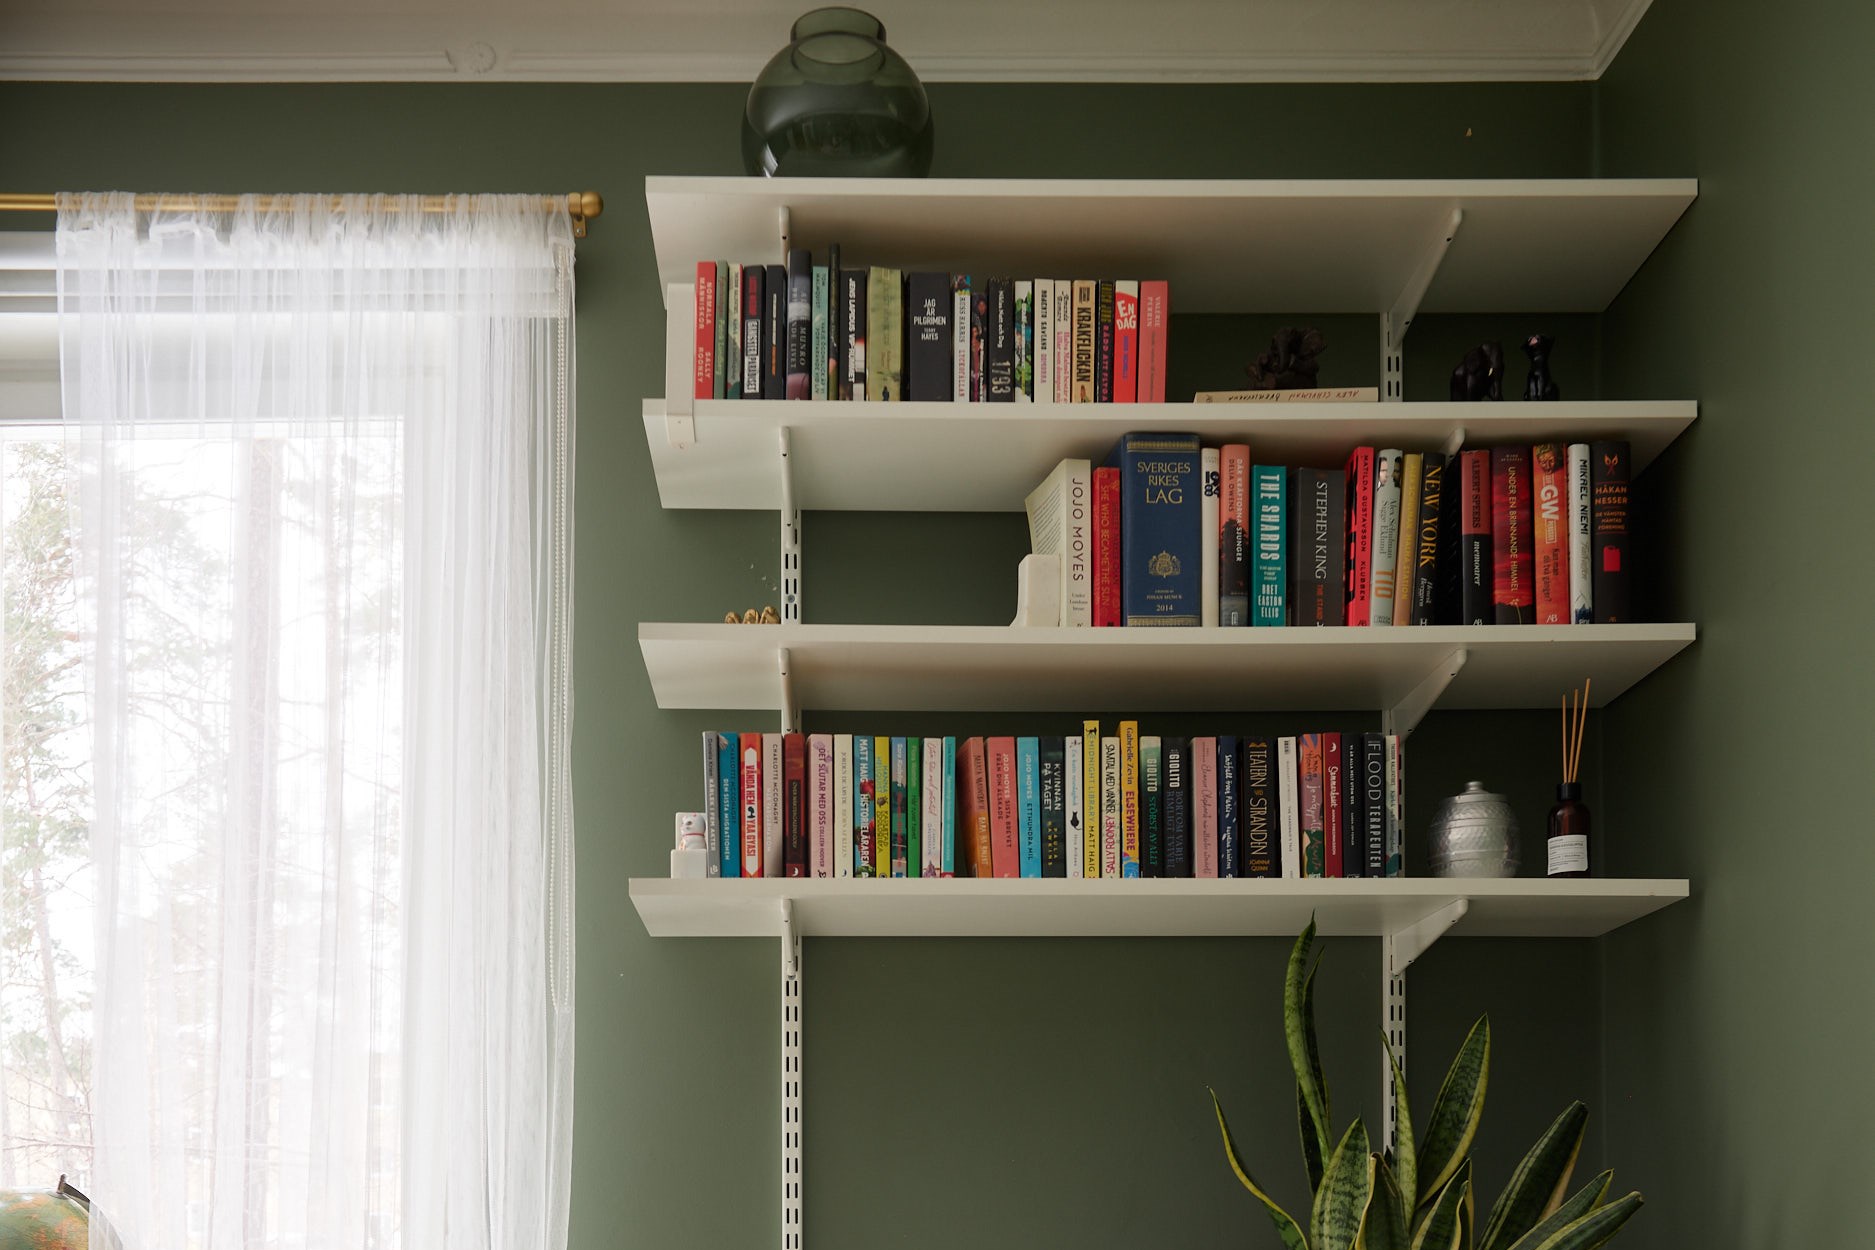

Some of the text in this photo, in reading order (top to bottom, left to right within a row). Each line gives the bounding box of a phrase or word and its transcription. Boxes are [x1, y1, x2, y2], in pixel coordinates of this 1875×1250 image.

[698, 277, 706, 330] MÄNNISKOR
[848, 300, 856, 332] LAPIDUS
[924, 299, 936, 308] JAG
[1116, 300, 1135, 318] EN
[913, 316, 947, 326] PILGRIMEN
[921, 332, 939, 341] HAYES
[1116, 315, 1137, 331] DAG
[799, 327, 807, 367] MUNRO
[697, 347, 705, 382] ROONEY
[991, 360, 1011, 394] 1793
[1101, 372, 1109, 402] FLYGA
[1137, 461, 1191, 474] SVERIGES
[1148, 475, 1180, 487] RIKES
[1507, 467, 1518, 495] UNDER
[1146, 488, 1183, 504] LAG
[1260, 474, 1280, 500] THE
[1471, 458, 1482, 529] ALBERT SPEERS
[1508, 496, 1517, 508] EN
[1540, 484, 1560, 520] GW
[1579, 459, 1589, 535] MIKAEL NIEMI
[1594, 497, 1628, 505] NESSER
[1595, 484, 1627, 494] HÅKAN
[1072, 477, 1084, 582] JOJO MOYES
[1315, 481, 1328, 580] STEPHEN KING
[1359, 455, 1369, 601] MATILDA GUSTAVSSON KLUBBEN
[1386, 498, 1398, 559] Alex Schulman
[1419, 464, 1443, 569] NEW YORK
[1100, 485, 1110, 606] SHE WHO BECAME THE SUN
[1235, 526, 1243, 562] SJUNGER
[1260, 504, 1280, 561] SHARDS
[1378, 525, 1389, 555] Eklund
[1508, 510, 1518, 559] BRINNANDE
[1472, 540, 1482, 587] memoarer
[1510, 560, 1519, 592] HIMMEL
[1261, 584, 1277, 595] BRET
[1375, 569, 1394, 599] TID
[1401, 565, 1411, 600] STATION
[1155, 603, 1173, 612] 2014
[1258, 595, 1282, 606] EASTON
[1261, 607, 1279, 618] ELLIS
[818, 748, 826, 761] DET
[1002, 753, 1010, 772] JOJO
[1105, 744, 1115, 770] SAMTAL
[1126, 727, 1134, 785] Gabrielle Zevin
[818, 763, 826, 791] SLUTAR
[1105, 771, 1115, 787] MED
[1146, 758, 1158, 792] GIOLITO
[1169, 753, 1180, 788] GIOLITO
[1223, 754, 1234, 814] Snöfall Paris
[746, 790, 755, 805] HEM
[818, 793, 826, 809] MED
[1043, 762, 1053, 811] PÅ TÅGET
[1053, 763, 1062, 811] KVINNAN
[818, 810, 826, 825] OSS
[860, 739, 871, 867] MATT HAIG HISTORIELÄRAREN
[1088, 740, 1096, 873] MIDNIGHT LIBRARY MATT HAIG
[1175, 790, 1184, 833] BORTOM
[1199, 789, 1212, 818] Oliphant
[1249, 750, 1268, 855] TEATERN STRANDEN
[1367, 744, 1382, 868] FLOOD TERAPEUTEN
[746, 819, 756, 833] YAA
[1026, 803, 1034, 845] ETTHUNDRA
[1125, 790, 1136, 851] ELSEWHERE
[746, 834, 756, 857] GYASI
[1105, 815, 1115, 874] SALLY ROONEY
[1149, 832, 1158, 844] AV
[1174, 834, 1185, 863] VARJE
[1149, 845, 1158, 865] ALLT
